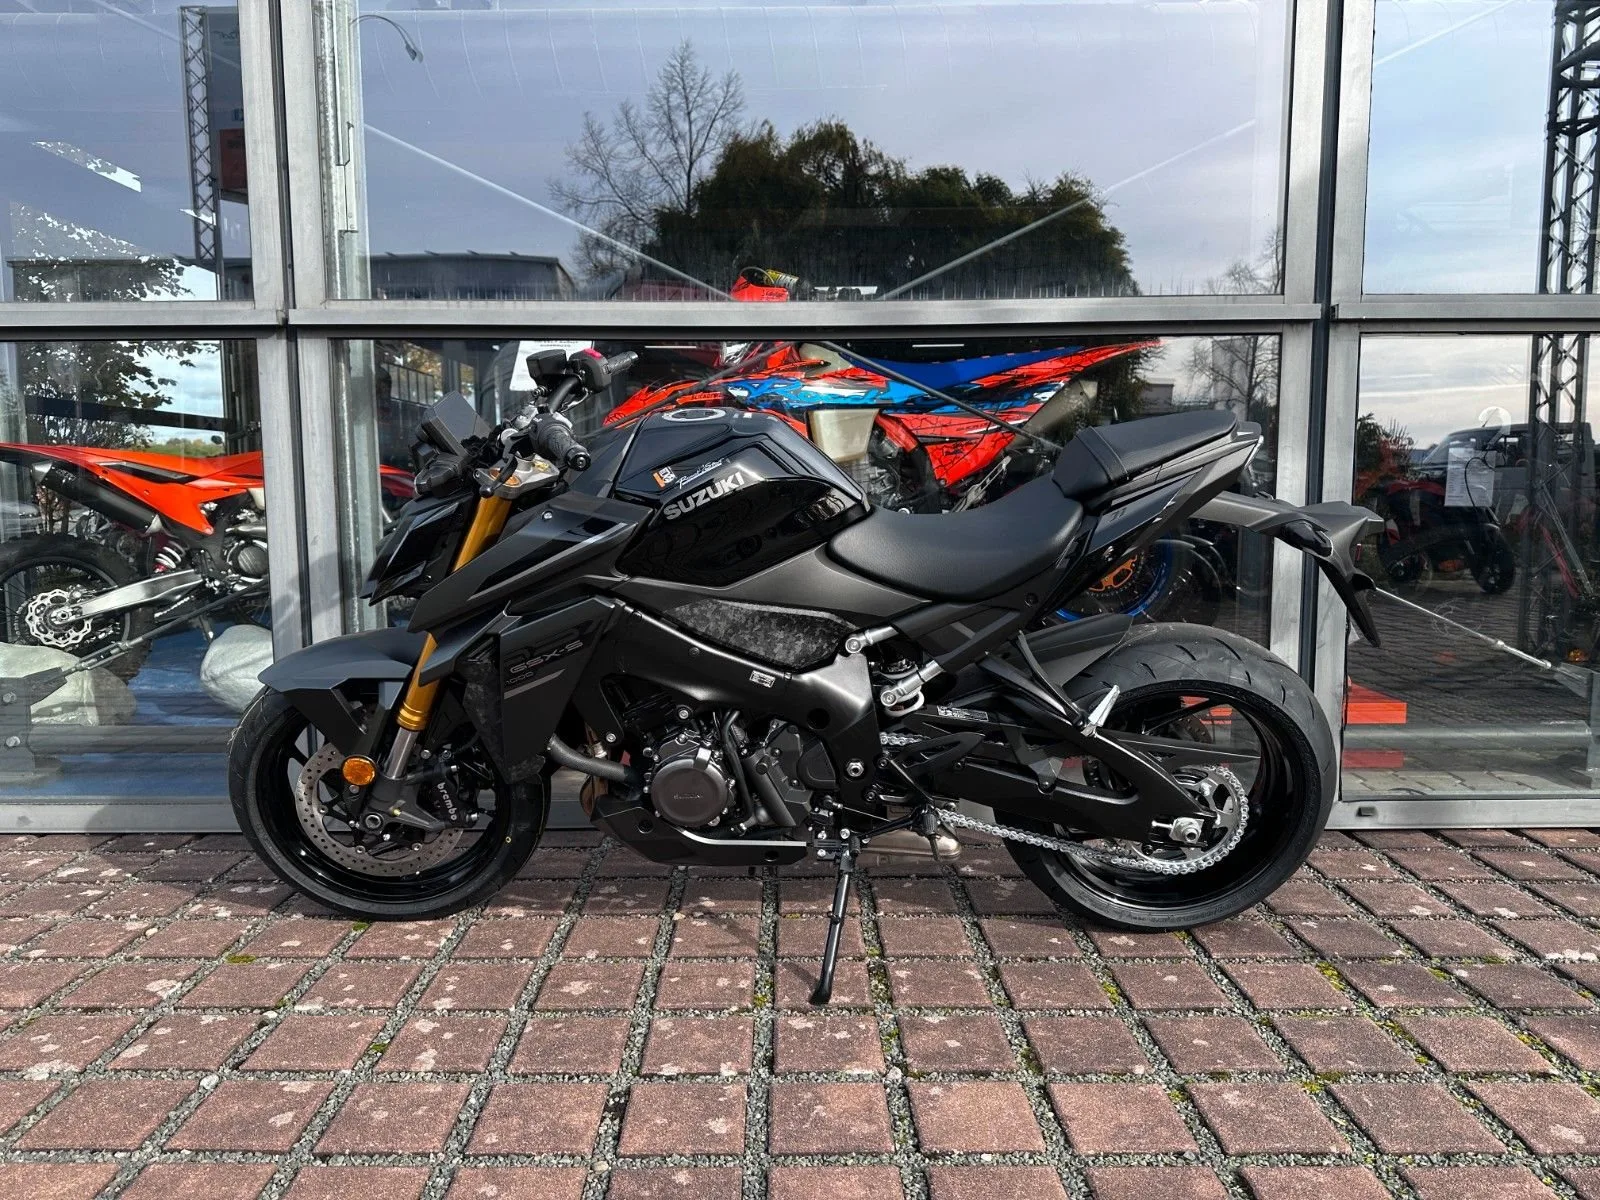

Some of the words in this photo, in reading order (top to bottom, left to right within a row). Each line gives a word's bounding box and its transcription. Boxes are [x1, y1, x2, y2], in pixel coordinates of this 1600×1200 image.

[663, 472, 745, 520] SUZUKI
[509, 639, 584, 675] GSX-S
[437, 782, 458, 821] brembo
